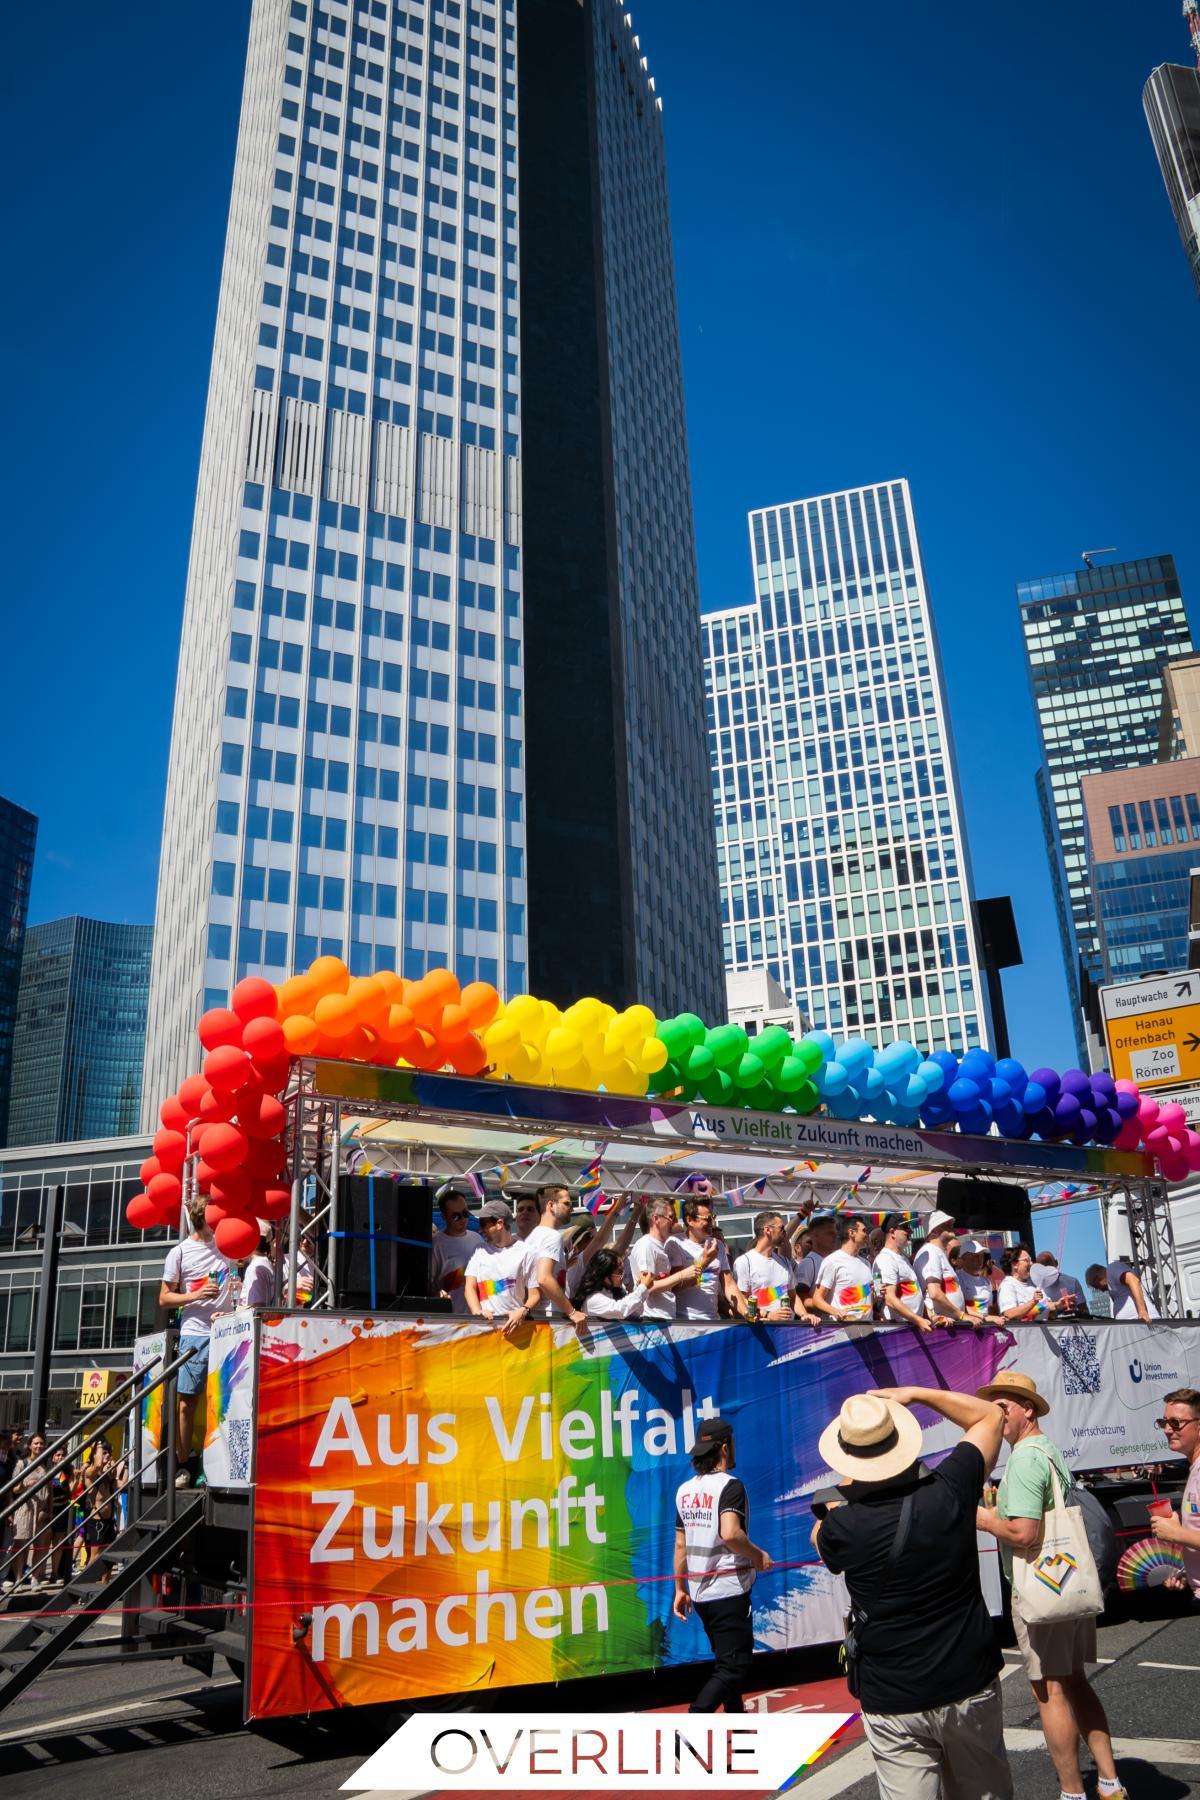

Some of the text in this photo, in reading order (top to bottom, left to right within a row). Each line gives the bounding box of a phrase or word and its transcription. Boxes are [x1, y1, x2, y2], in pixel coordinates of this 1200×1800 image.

[1115, 990, 1168, 1008] Hauptwache
[1135, 1017, 1173, 1031] Hanau
[1115, 1030, 1176, 1049] Offenbach
[1152, 1050, 1174, 1061] Zoo
[1135, 1064, 1176, 1079] Römer
[1185, 1110, 1194, 1118] or
[692, 1113, 923, 1152] Aus Vielfalt Zukunft machen
[1144, 1362, 1162, 1371] Union
[1145, 1371, 1178, 1380] Investment
[83, 1392, 106, 1404] TAXI
[309, 1396, 458, 1467] Aus
[1071, 1425, 1126, 1438] Wertschätzung
[1062, 1447, 1080, 1460] pekt
[309, 1475, 607, 1563] Zukunft
[311, 1569, 609, 1662] machen
